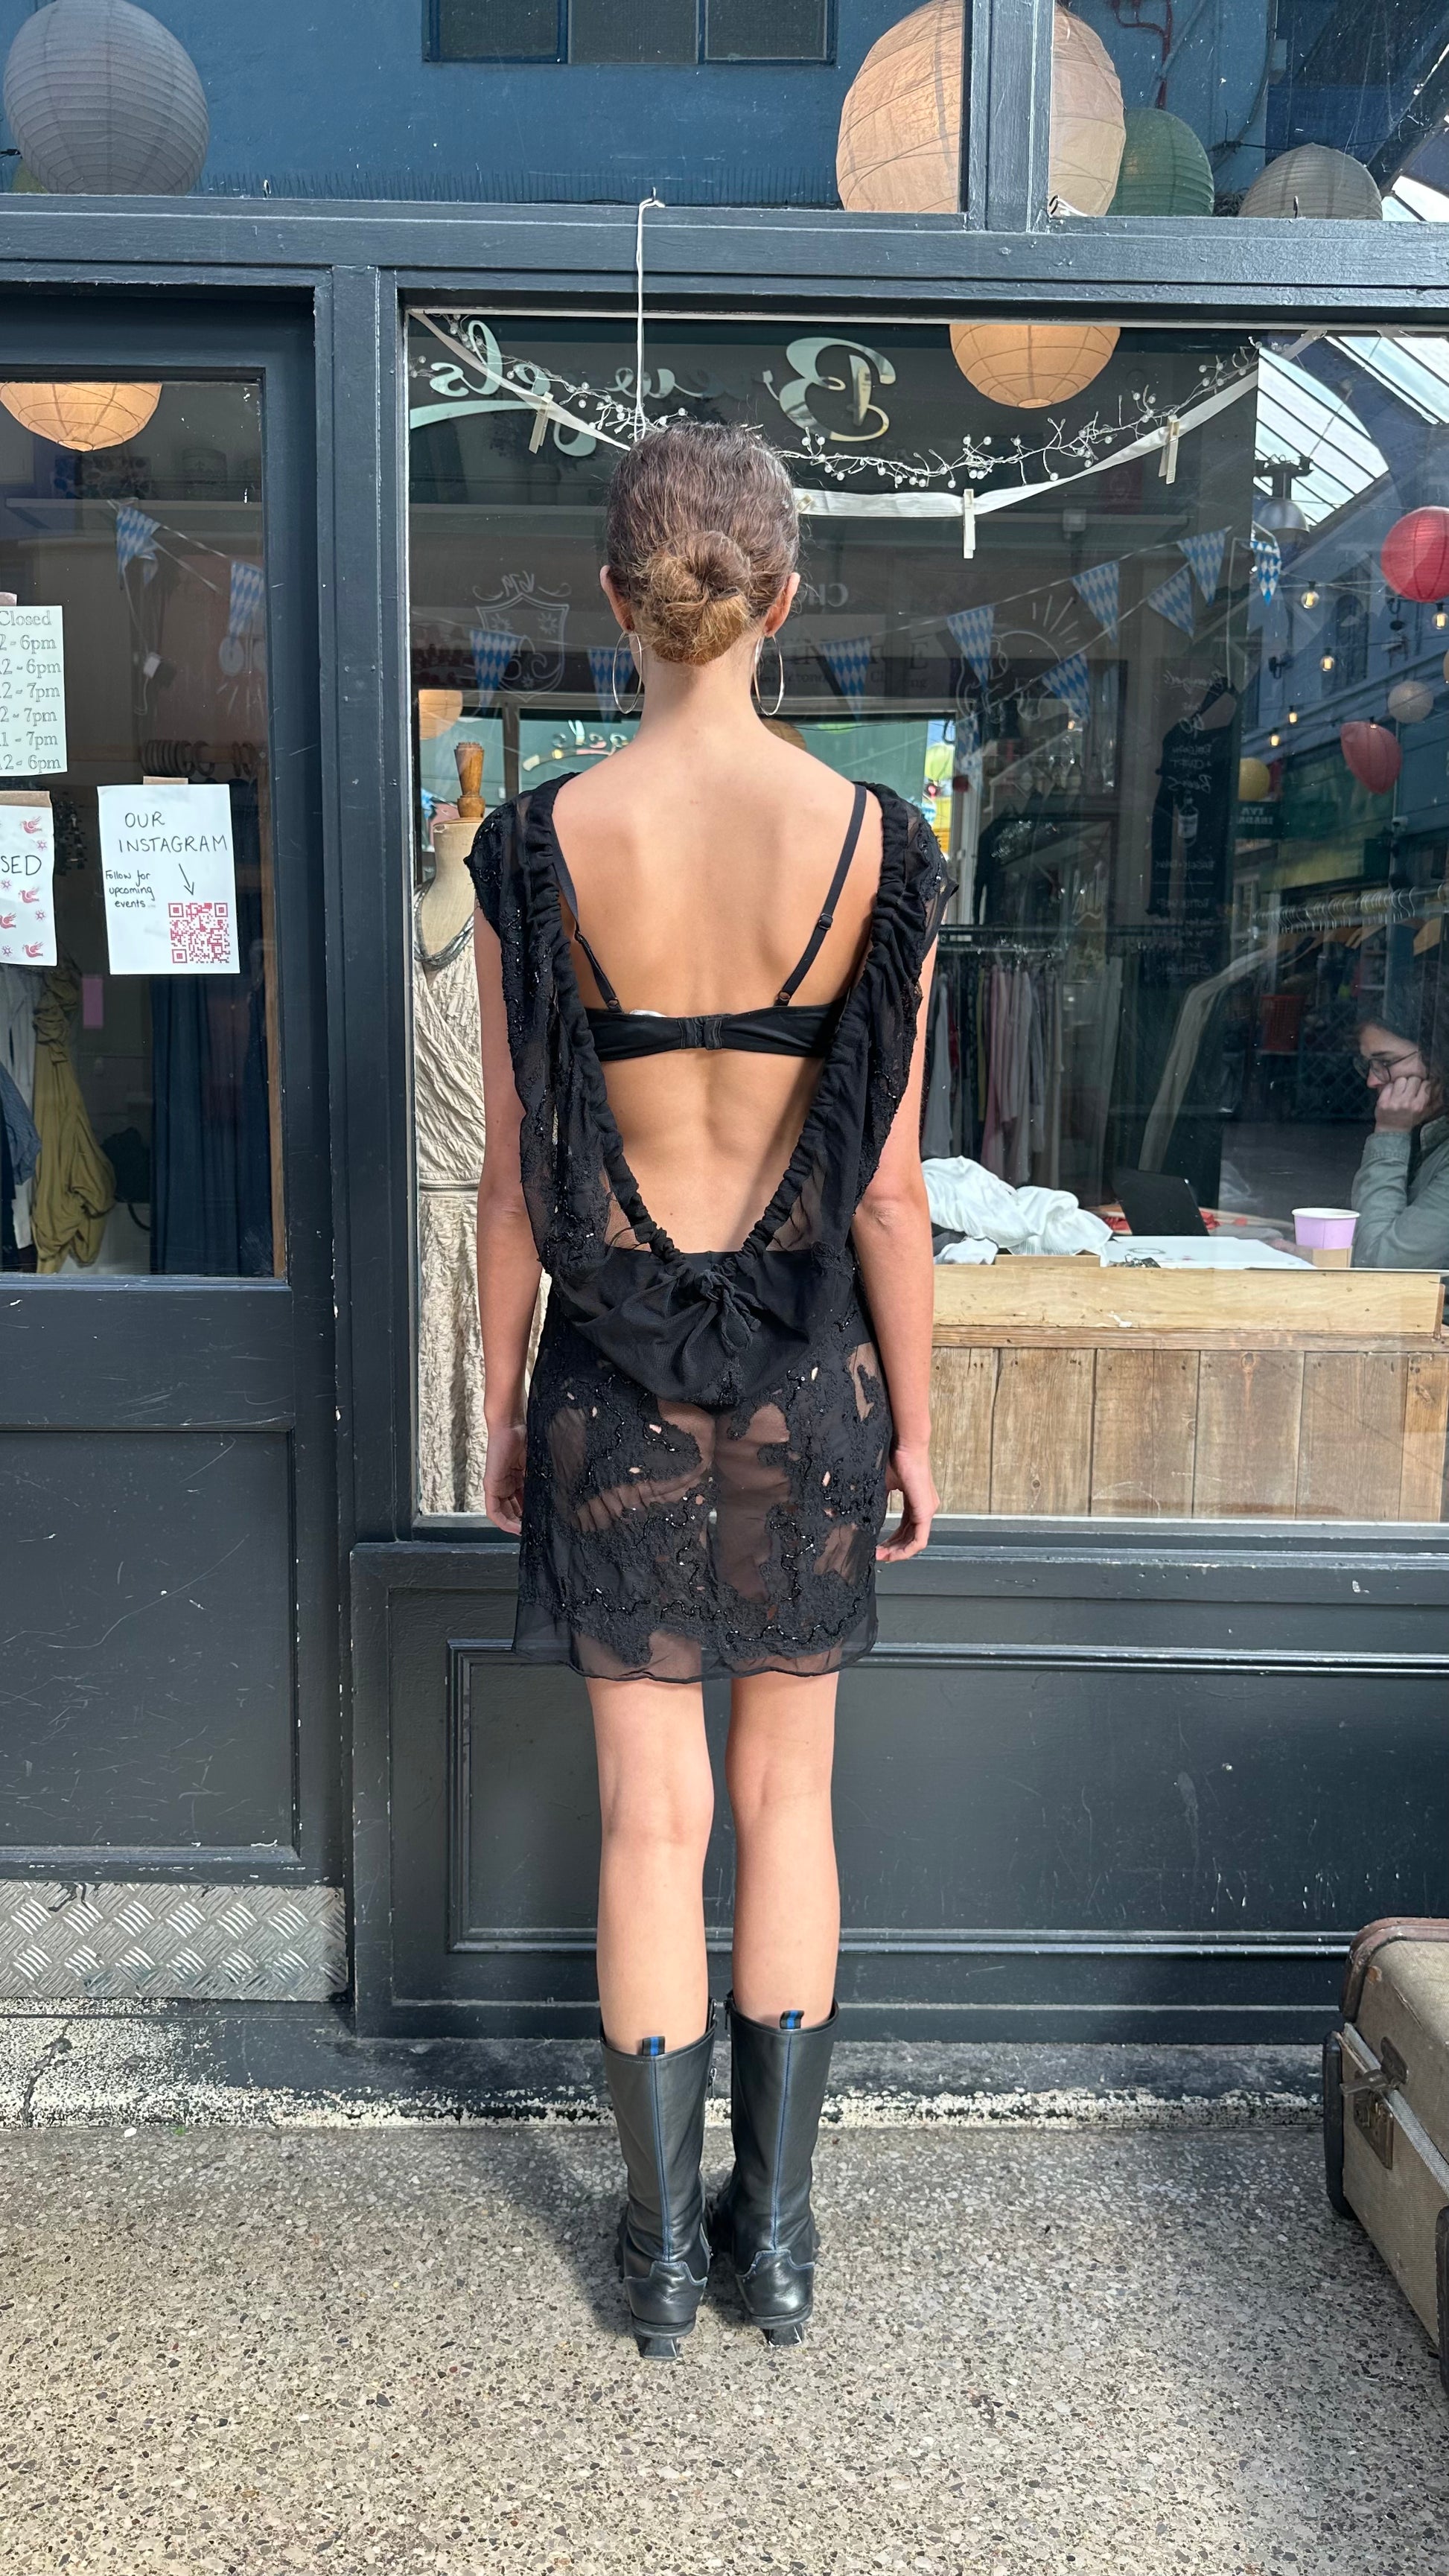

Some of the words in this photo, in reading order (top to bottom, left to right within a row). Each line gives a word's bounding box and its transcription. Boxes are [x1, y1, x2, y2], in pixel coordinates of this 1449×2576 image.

[0, 610, 52, 626] Closed
[20, 634, 57, 654] 6pm
[0, 659, 13, 675] 2
[27, 658, 61, 678] 6pm
[0, 681, 13, 699] 2
[27, 682, 60, 702] 7pm
[24, 707, 57, 727] 7pm
[26, 731, 58, 750] 7pm
[28, 754, 61, 774] 6pm
[125, 811, 165, 829] OUR
[118, 835, 228, 854] INSTAGRAM
[105, 870, 132, 880] Follow
[136, 870, 151, 887] for
[109, 886, 156, 902] upcoming
[115, 899, 146, 908] events
